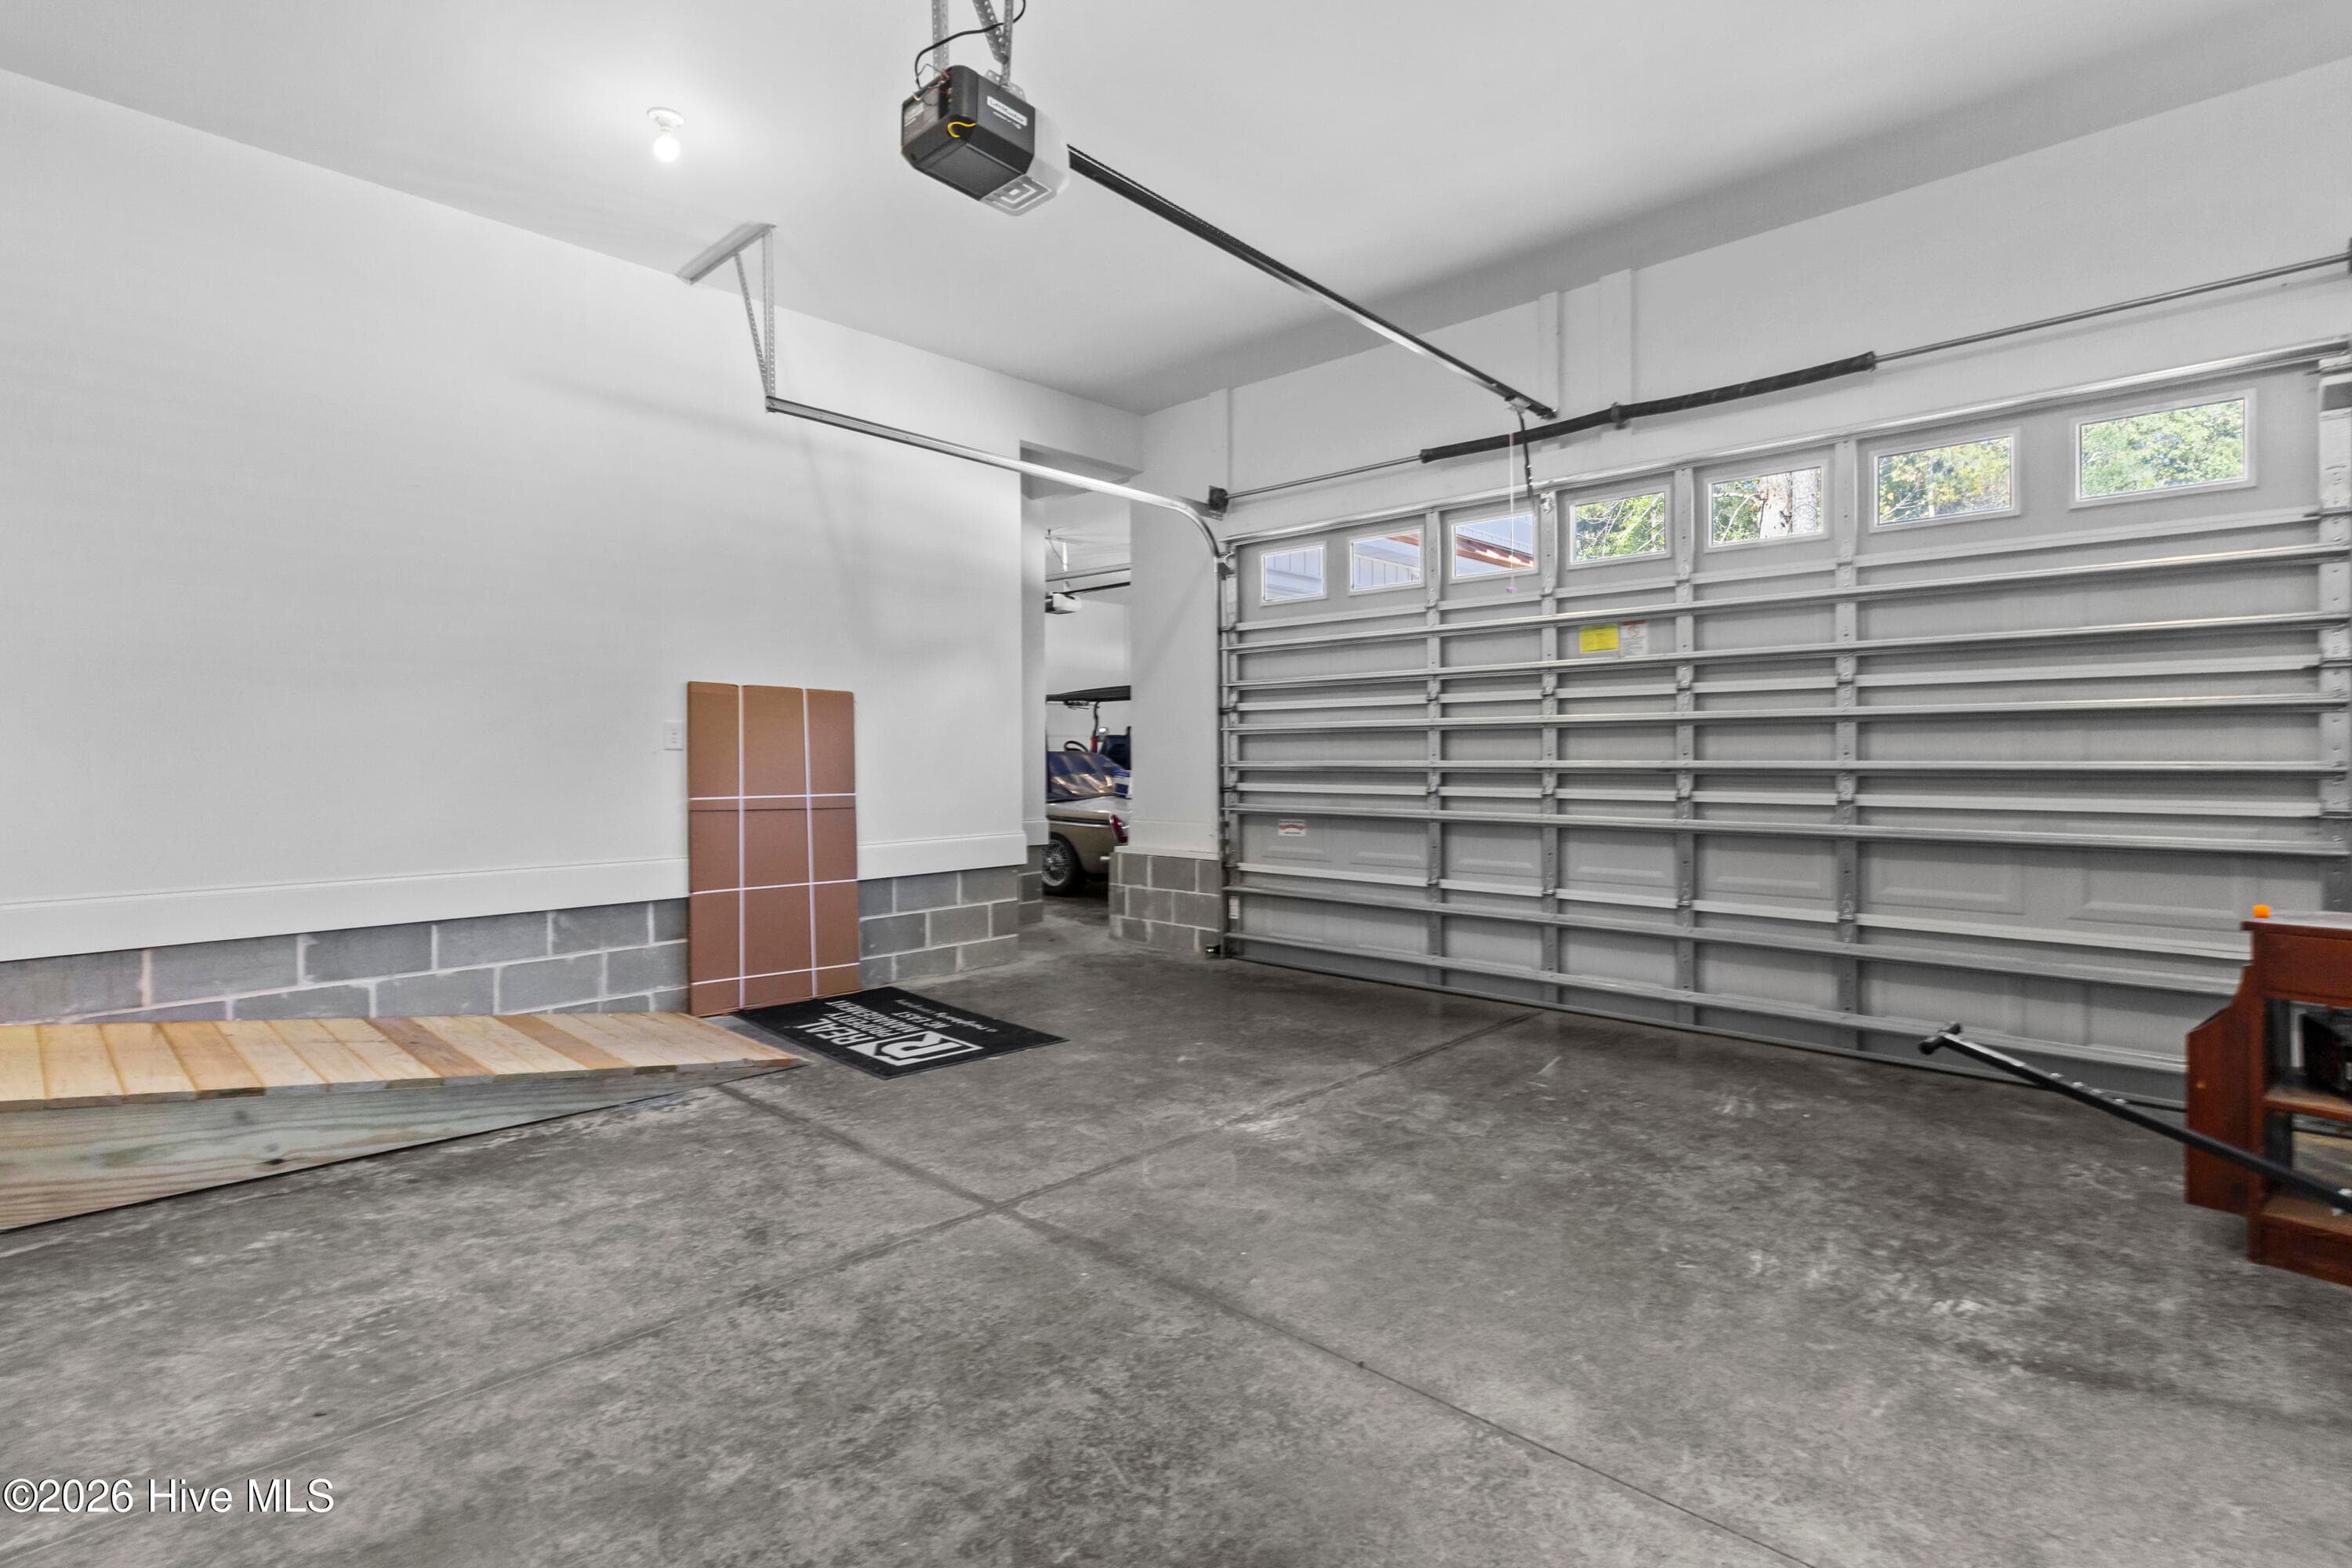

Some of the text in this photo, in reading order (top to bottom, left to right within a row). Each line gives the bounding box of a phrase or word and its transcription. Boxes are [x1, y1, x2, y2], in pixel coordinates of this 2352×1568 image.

[824, 1012, 901, 1037] PROPERTY
[826, 1000, 923, 1033] MANAGEMENT
[891, 1011, 933, 1023] EAST
[794, 1018, 876, 1045] REAL
